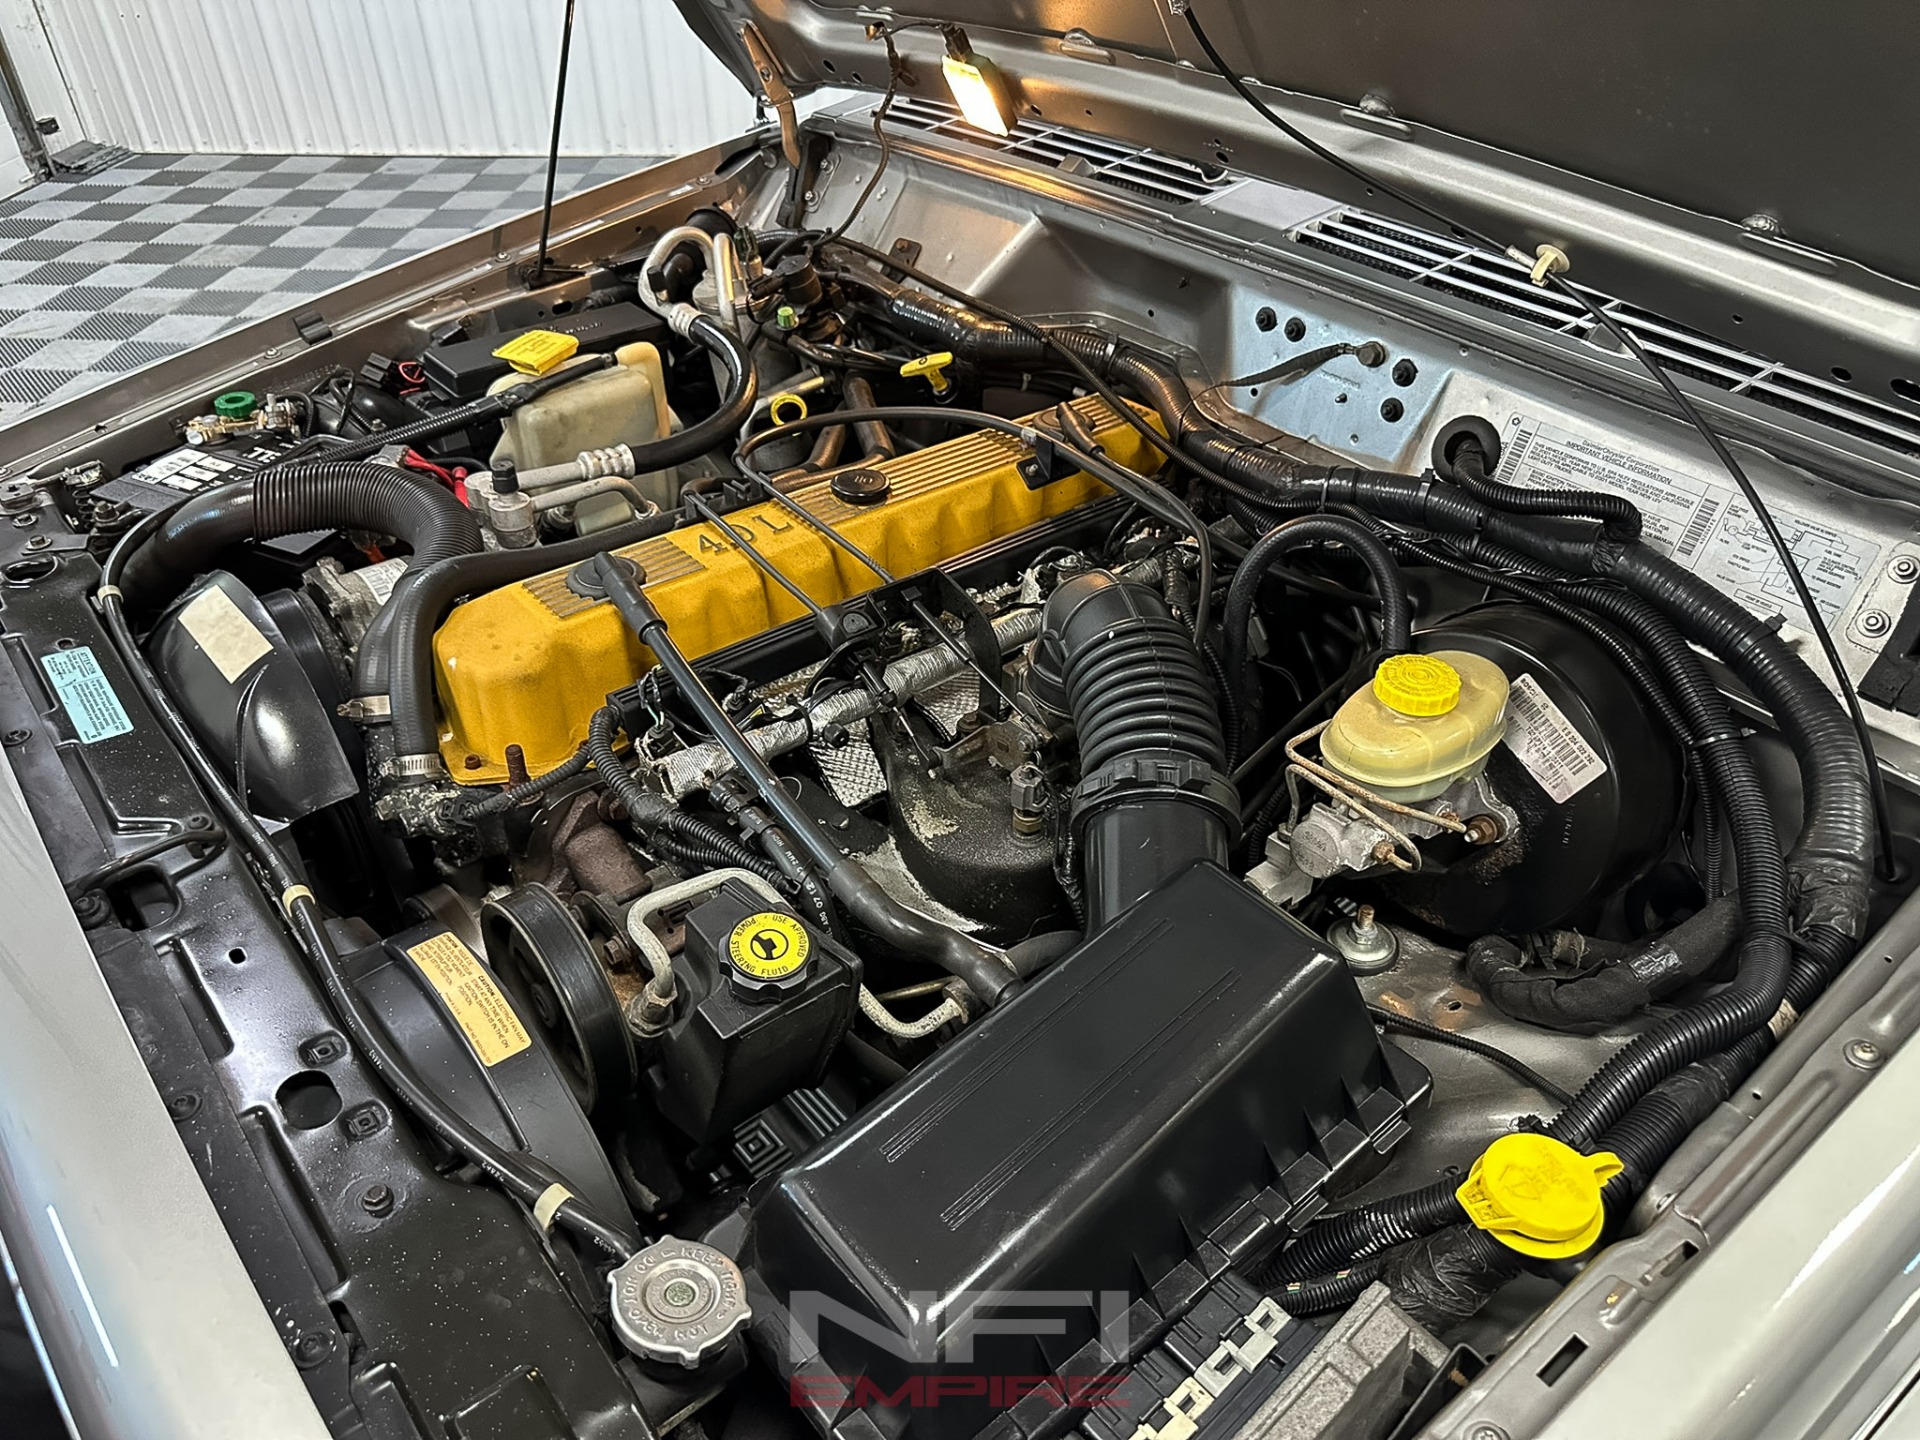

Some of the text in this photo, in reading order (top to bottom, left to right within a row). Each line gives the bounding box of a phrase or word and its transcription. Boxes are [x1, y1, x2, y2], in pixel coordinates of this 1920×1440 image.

[1565, 441, 1672, 484] IMPORTANT VEHICLE INFORMATION
[730, 917, 789, 976] POWER STEERING FLUID
[772, 915, 808, 958] USE APPROVED
